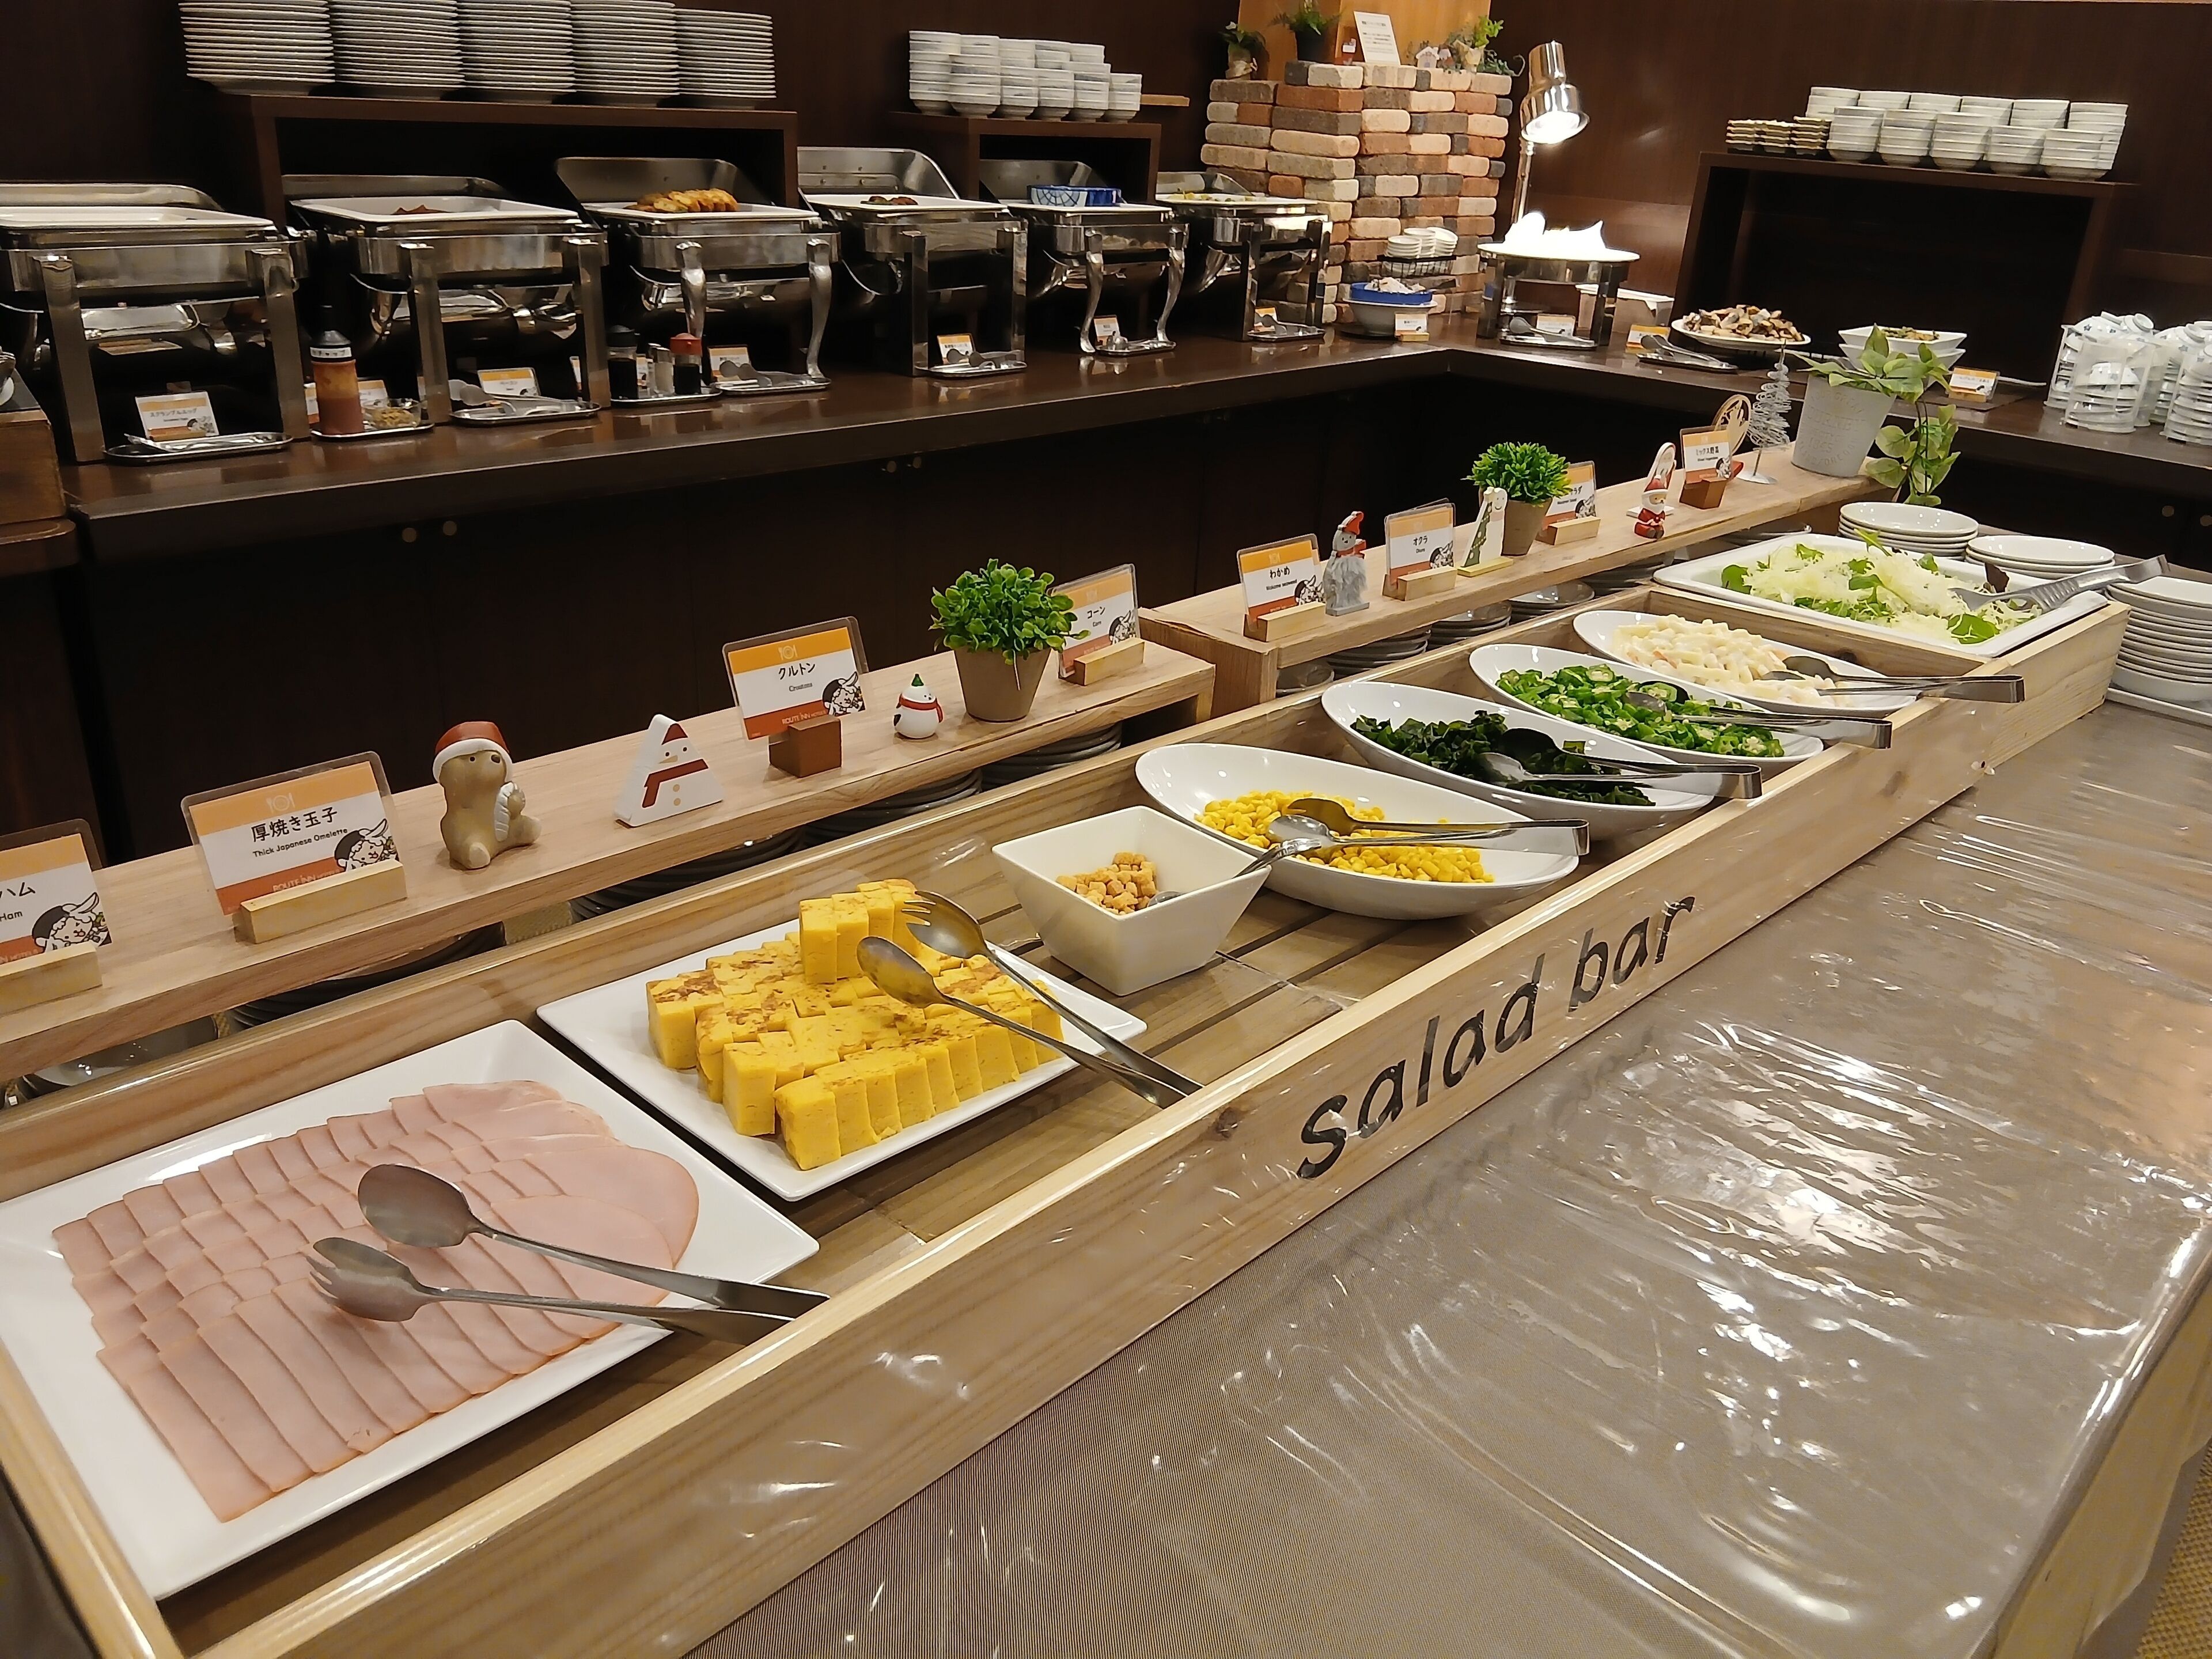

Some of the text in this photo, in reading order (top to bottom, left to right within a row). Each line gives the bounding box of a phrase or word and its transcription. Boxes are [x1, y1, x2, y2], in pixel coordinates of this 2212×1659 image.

[1413, 535, 1428, 546] オクラ
[1270, 566, 1290, 579] わかめ
[1087, 606, 1105, 619] コーン
[779, 662, 816, 680] クルトン
[781, 715, 800, 725] ROUTE
[251, 806, 338, 843] 厚焼き玉子
[252, 828, 348, 857] Thick Japanese Omelette
[0, 911, 23, 923] Ham
[1296, 896, 1696, 1179] salad bar
